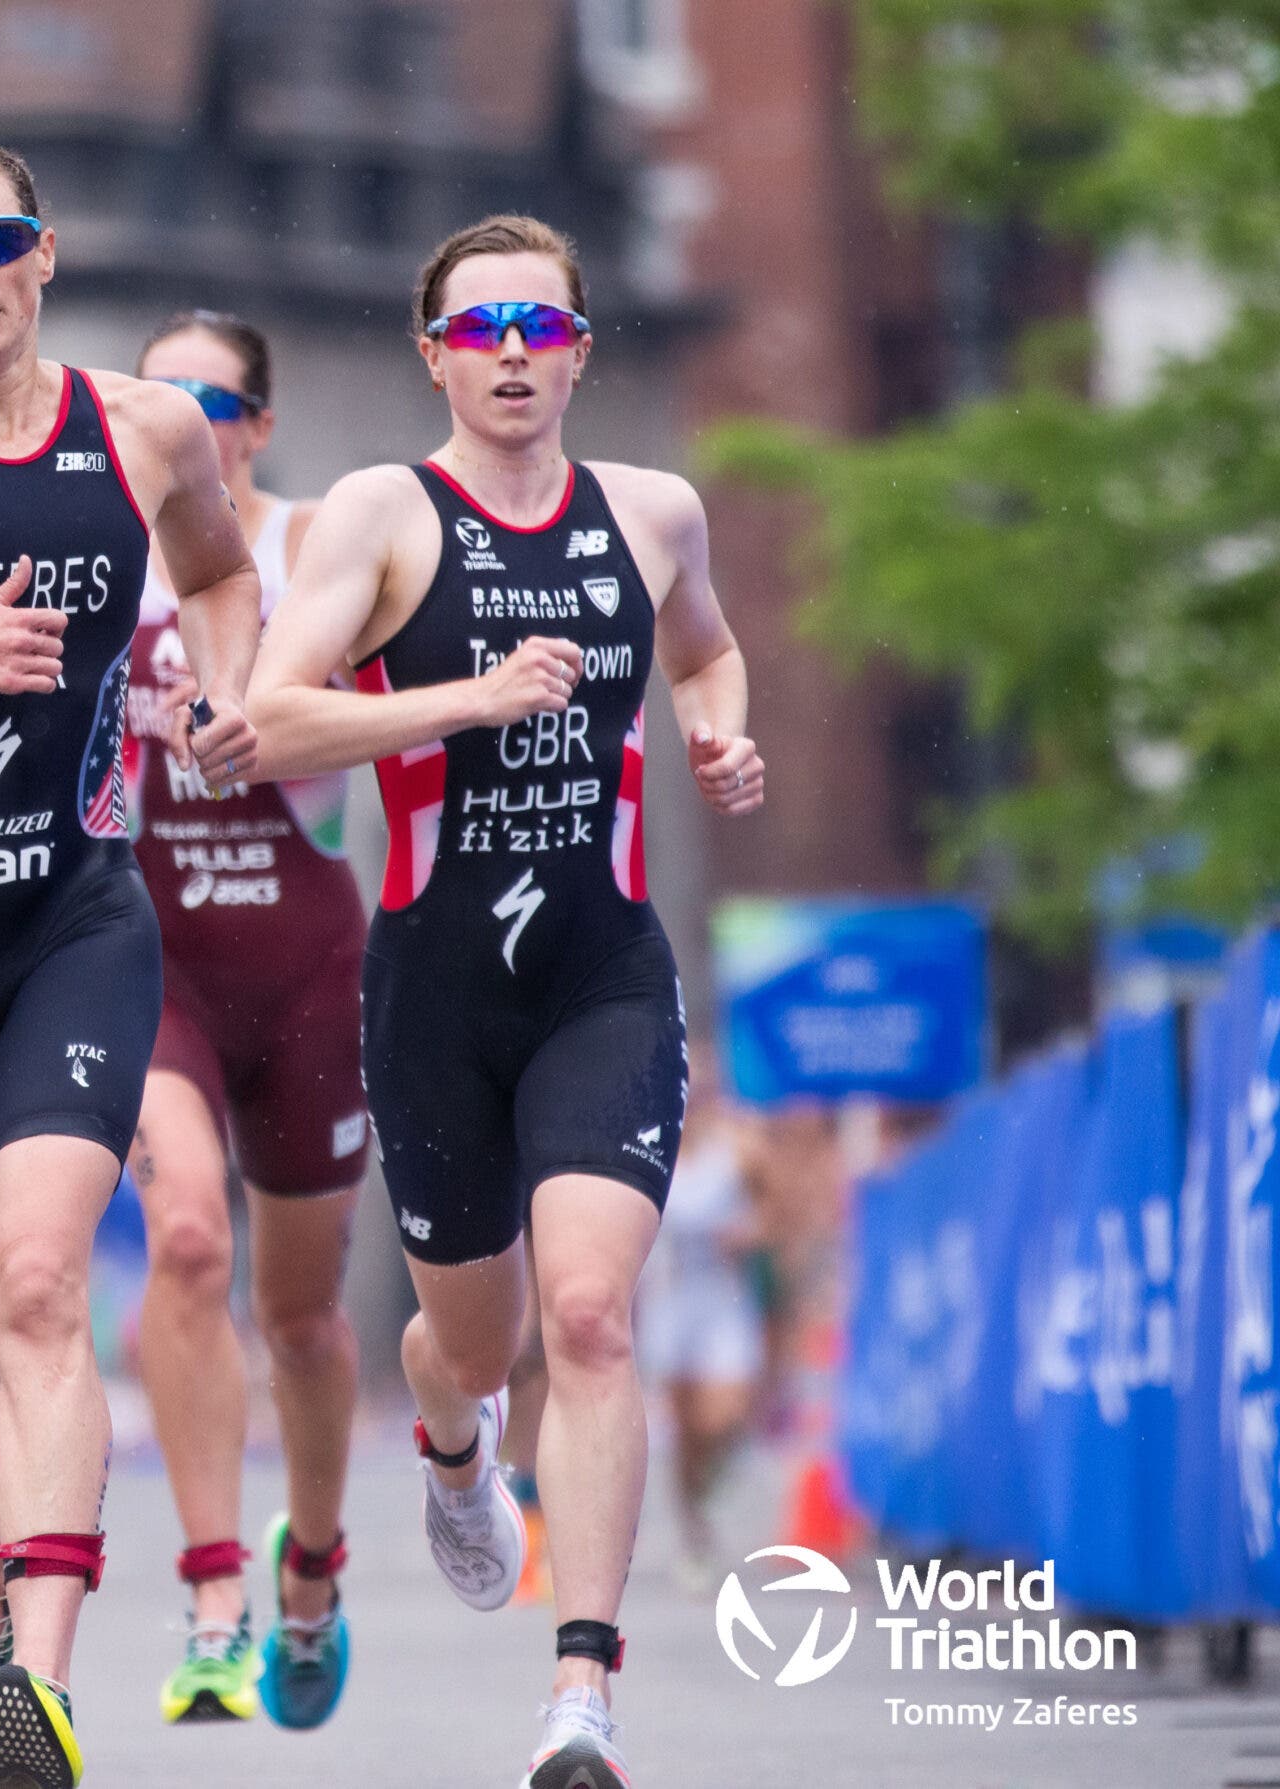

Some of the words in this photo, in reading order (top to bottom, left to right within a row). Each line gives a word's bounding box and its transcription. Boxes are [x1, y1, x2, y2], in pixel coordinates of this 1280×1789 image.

[462, 560, 507, 571] Triathlon
[466, 550, 497, 561] World
[472, 587, 579, 607] BAHRAIN
[472, 604, 581, 619] VICTORIOUS
[500, 705, 594, 770] GBR
[463, 779, 601, 814] HUUB
[65, 1043, 108, 1063] NYAC
